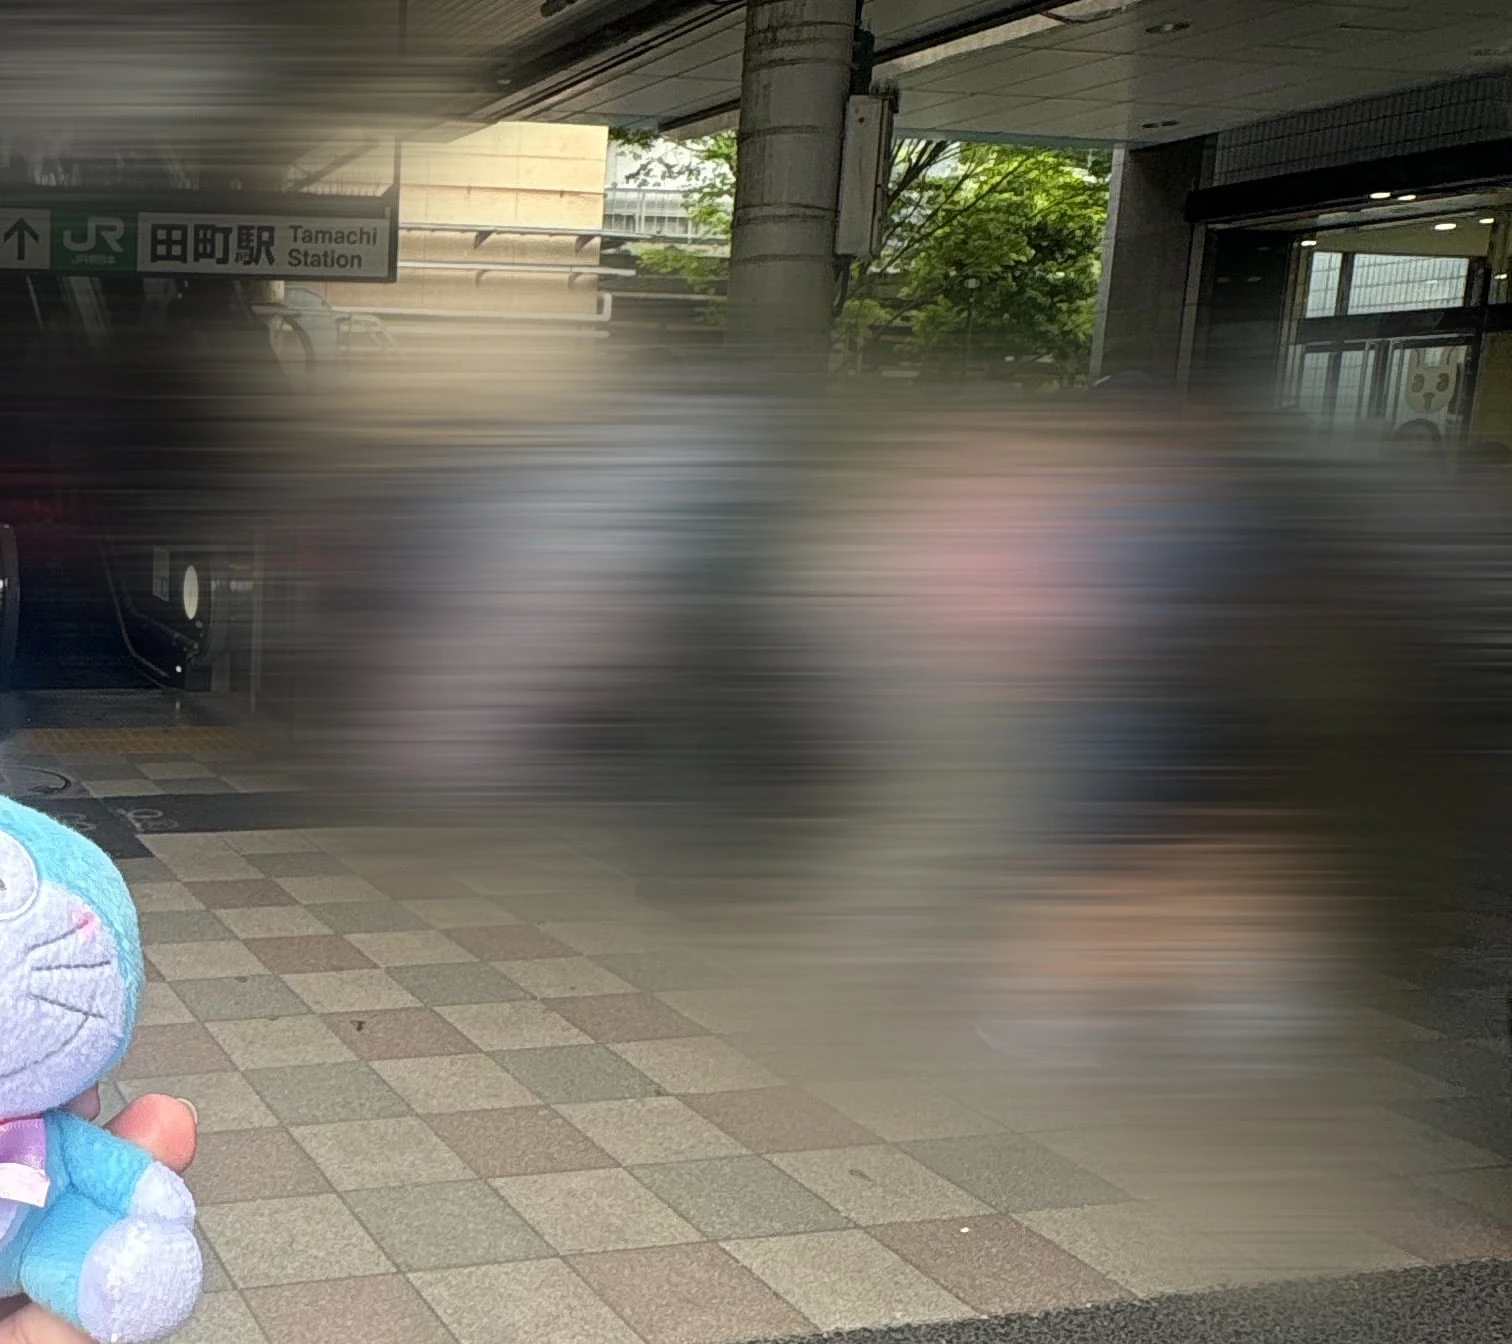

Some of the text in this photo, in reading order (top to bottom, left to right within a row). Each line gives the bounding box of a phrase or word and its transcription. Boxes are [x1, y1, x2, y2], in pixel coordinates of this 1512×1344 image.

[63, 216, 125, 253] JR
[150, 223, 276, 267] 田町駅
[289, 224, 378, 247] Tamachi
[288, 249, 363, 269] Station
